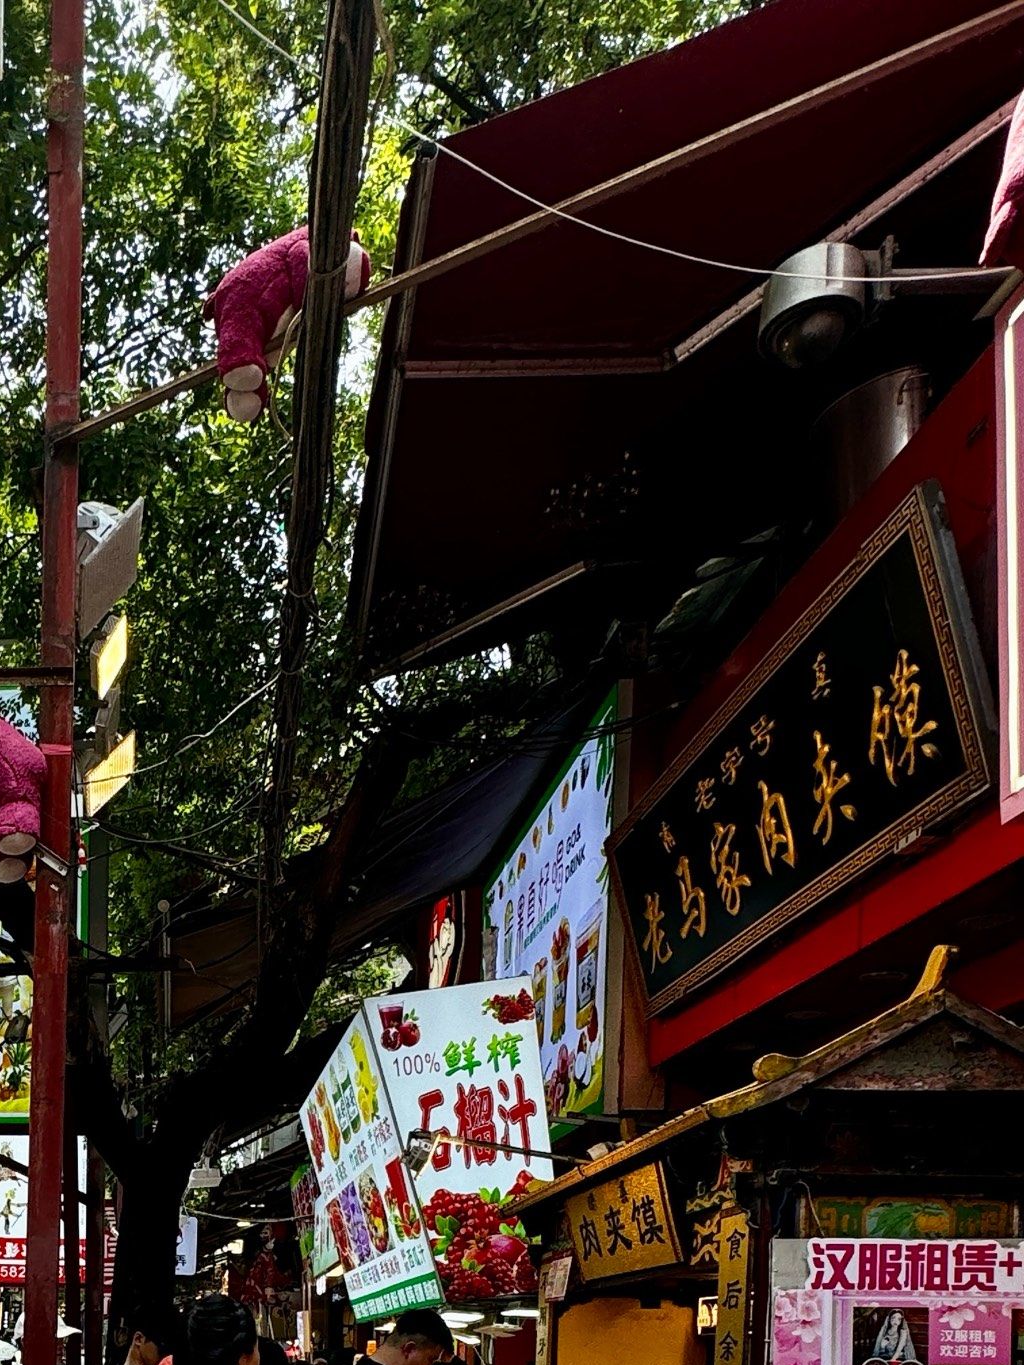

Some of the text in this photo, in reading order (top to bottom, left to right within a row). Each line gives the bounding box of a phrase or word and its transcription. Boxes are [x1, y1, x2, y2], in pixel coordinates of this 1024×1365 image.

[565, 843, 586, 884] DRINK
[392, 1031, 524, 1078] 100% 鲜榨
[417, 1073, 537, 1172] 石榴汁
[578, 1194, 666, 1262] 肉夹馍
[939, 1329, 996, 1343] 汉服租售
[939, 1344, 997, 1358] 欢迎咨询
